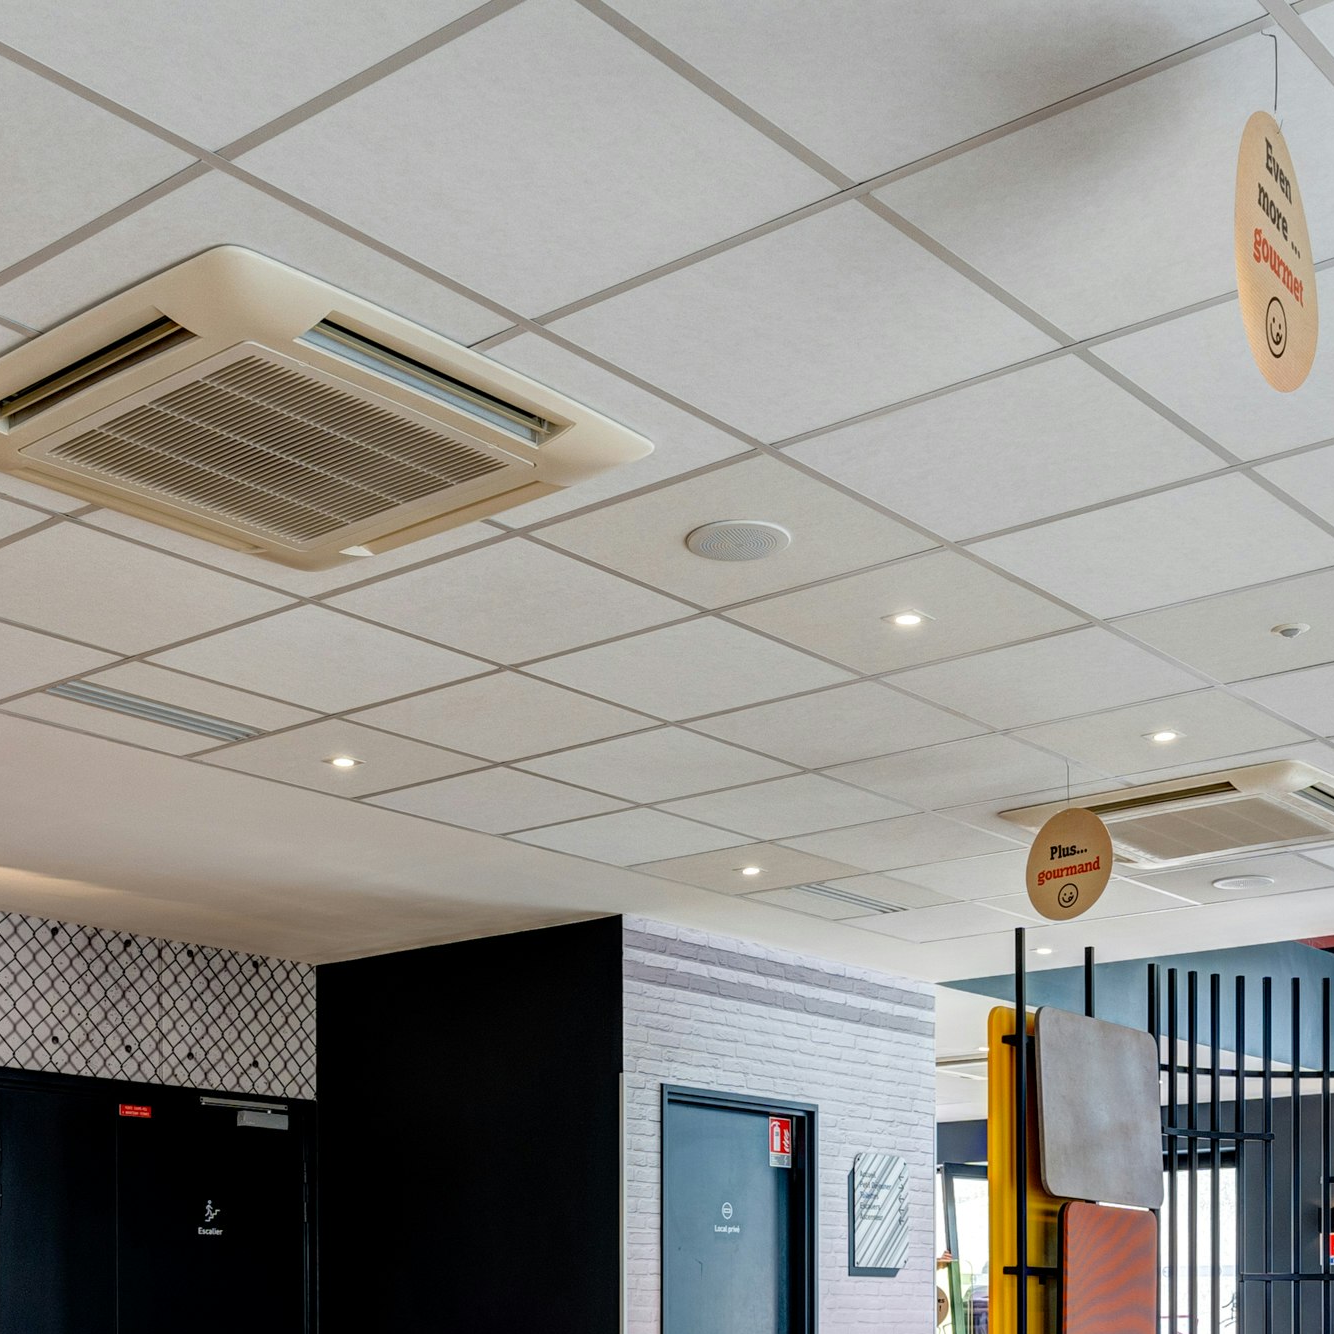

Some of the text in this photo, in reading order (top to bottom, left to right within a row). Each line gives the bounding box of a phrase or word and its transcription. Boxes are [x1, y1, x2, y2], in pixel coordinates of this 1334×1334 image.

[1264, 137, 1292, 204] Even
[1257, 182, 1288, 242] more
[1253, 228, 1304, 308] gourmet
[1037, 856, 1101, 886] gourmand
[1050, 844, 1088, 860] Plus...
[198, 1227, 223, 1235] Escalier
